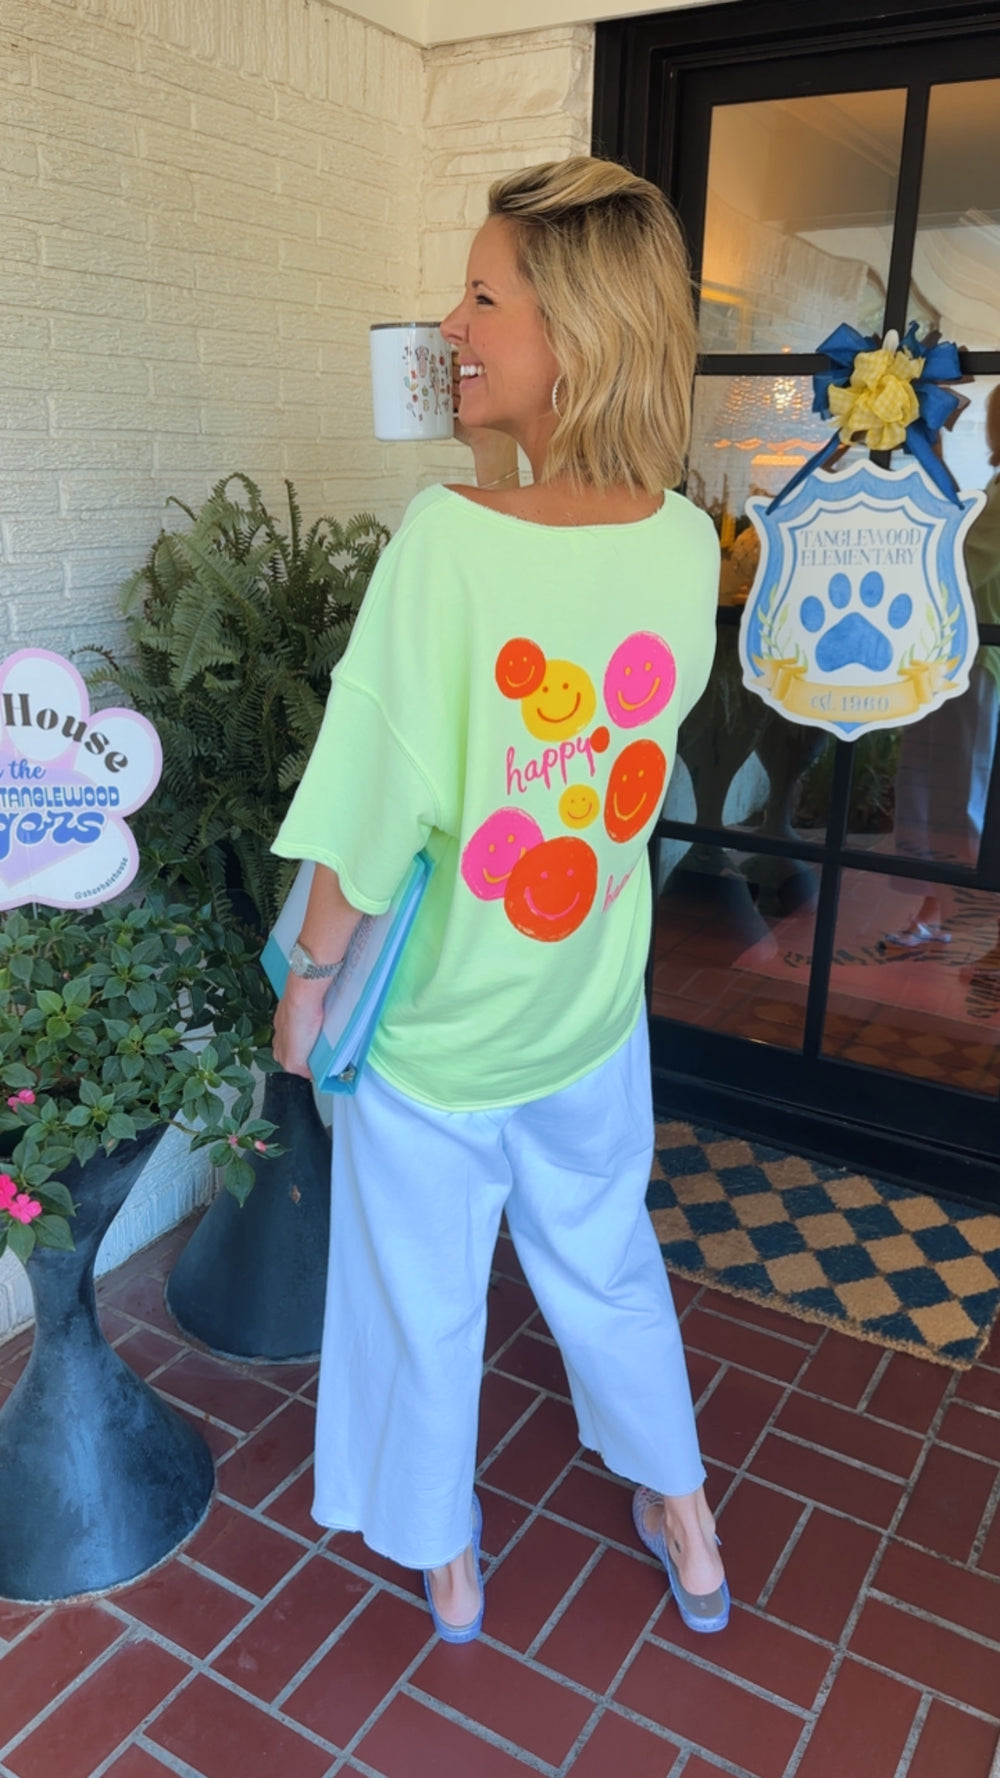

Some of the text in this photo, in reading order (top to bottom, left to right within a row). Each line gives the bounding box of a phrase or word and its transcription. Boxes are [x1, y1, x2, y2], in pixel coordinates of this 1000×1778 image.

[800, 528, 922, 548] TANGLEWOOD
[800, 548, 919, 567] ELEMENTARY
[841, 695, 890, 712] 1960
[2, 693, 128, 773] House
[9, 758, 47, 780] the
[506, 736, 596, 796] happy
[0, 785, 120, 808] TANGLEWOOD
